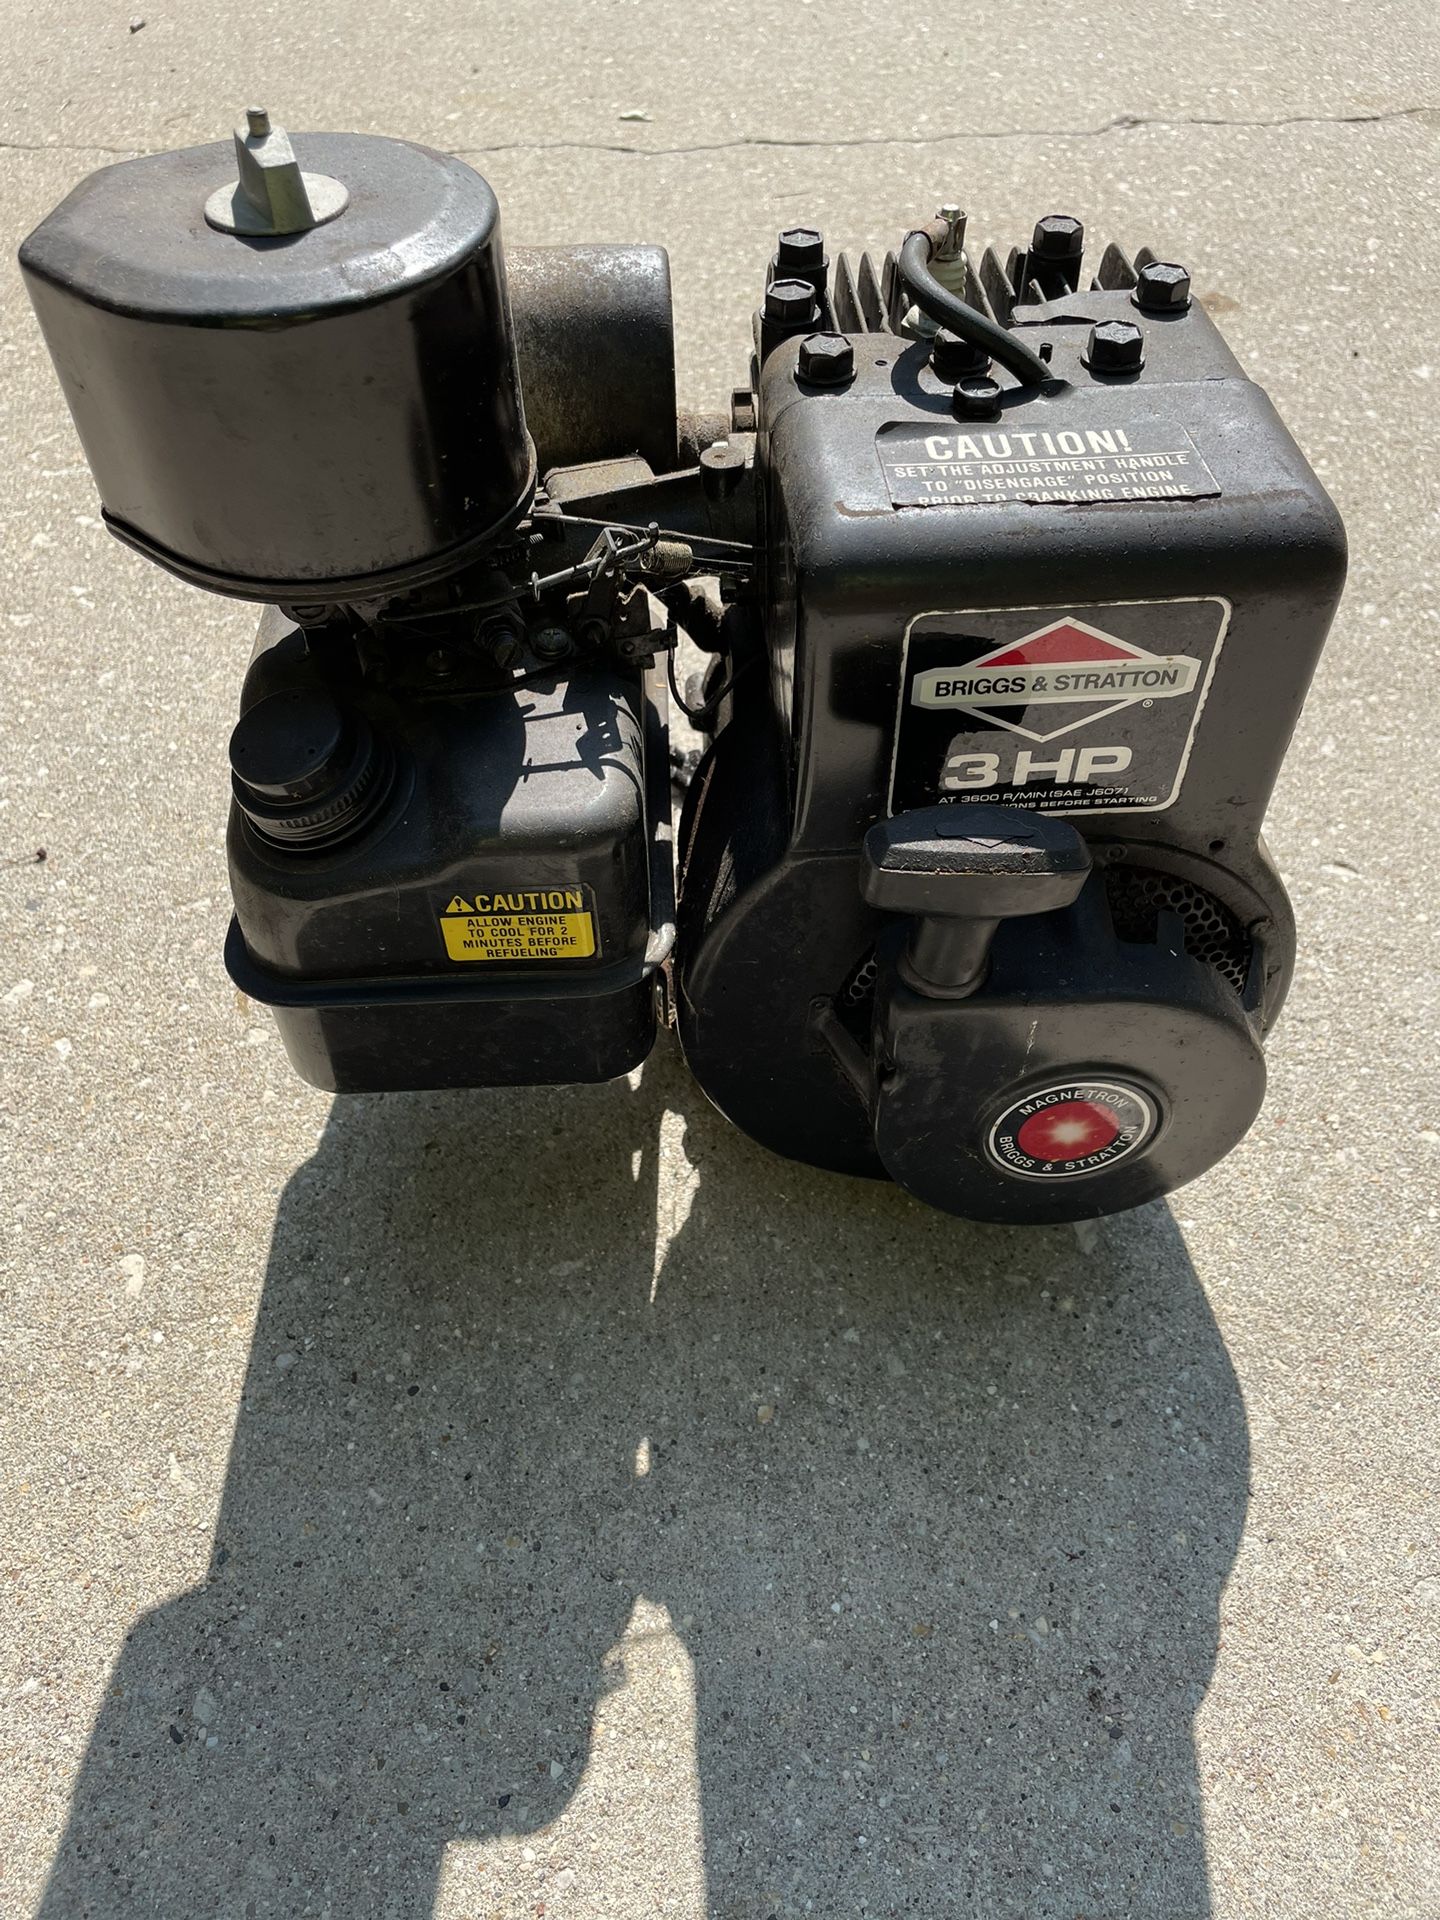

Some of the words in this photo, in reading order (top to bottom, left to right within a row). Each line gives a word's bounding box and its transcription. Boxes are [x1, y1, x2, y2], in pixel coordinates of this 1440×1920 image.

[926, 429, 1133, 461] CAUTION!
[894, 467, 925, 479] SET
[940, 464, 974, 477] THE
[981, 459, 1107, 476] ADJUSTMENT
[1116, 454, 1190, 470] HANDLE
[921, 480, 948, 492] TO
[1085, 470, 1174, 485] POSITION
[1121, 484, 1192, 499] ENGINE
[934, 676, 1026, 698] BRIGGS
[1031, 675, 1048, 692] &
[1053, 669, 1178, 691] STRATTON
[944, 753, 1000, 790] 3
[1012, 746, 1133, 786] HP
[960, 794, 1000, 803] 3600
[1002, 790, 1047, 802] R/MIN
[1049, 789, 1083, 798] (SAE
[1086, 787, 1129, 796] J607)
[1040, 800, 1090, 808] BEFORE
[1094, 796, 1158, 805] STARTING
[475, 891, 583, 912] CAUTION
[467, 917, 513, 928] ALLOW
[518, 916, 566, 926] ENGINE
[468, 928, 485, 938] TO
[490, 928, 525, 937] COOL
[530, 926, 555, 936] FOR
[561, 926, 568, 936] 2
[463, 938, 523, 949] MINUTES
[528, 936, 577, 946] BEFORE
[487, 948, 558, 958] REFUELING
[1018, 1089, 1129, 1116] MAGNETRON
[999, 1135, 1036, 1169] BRIGGS
[1042, 1162, 1053, 1172] &
[1065, 1125, 1138, 1171] STRATTON
